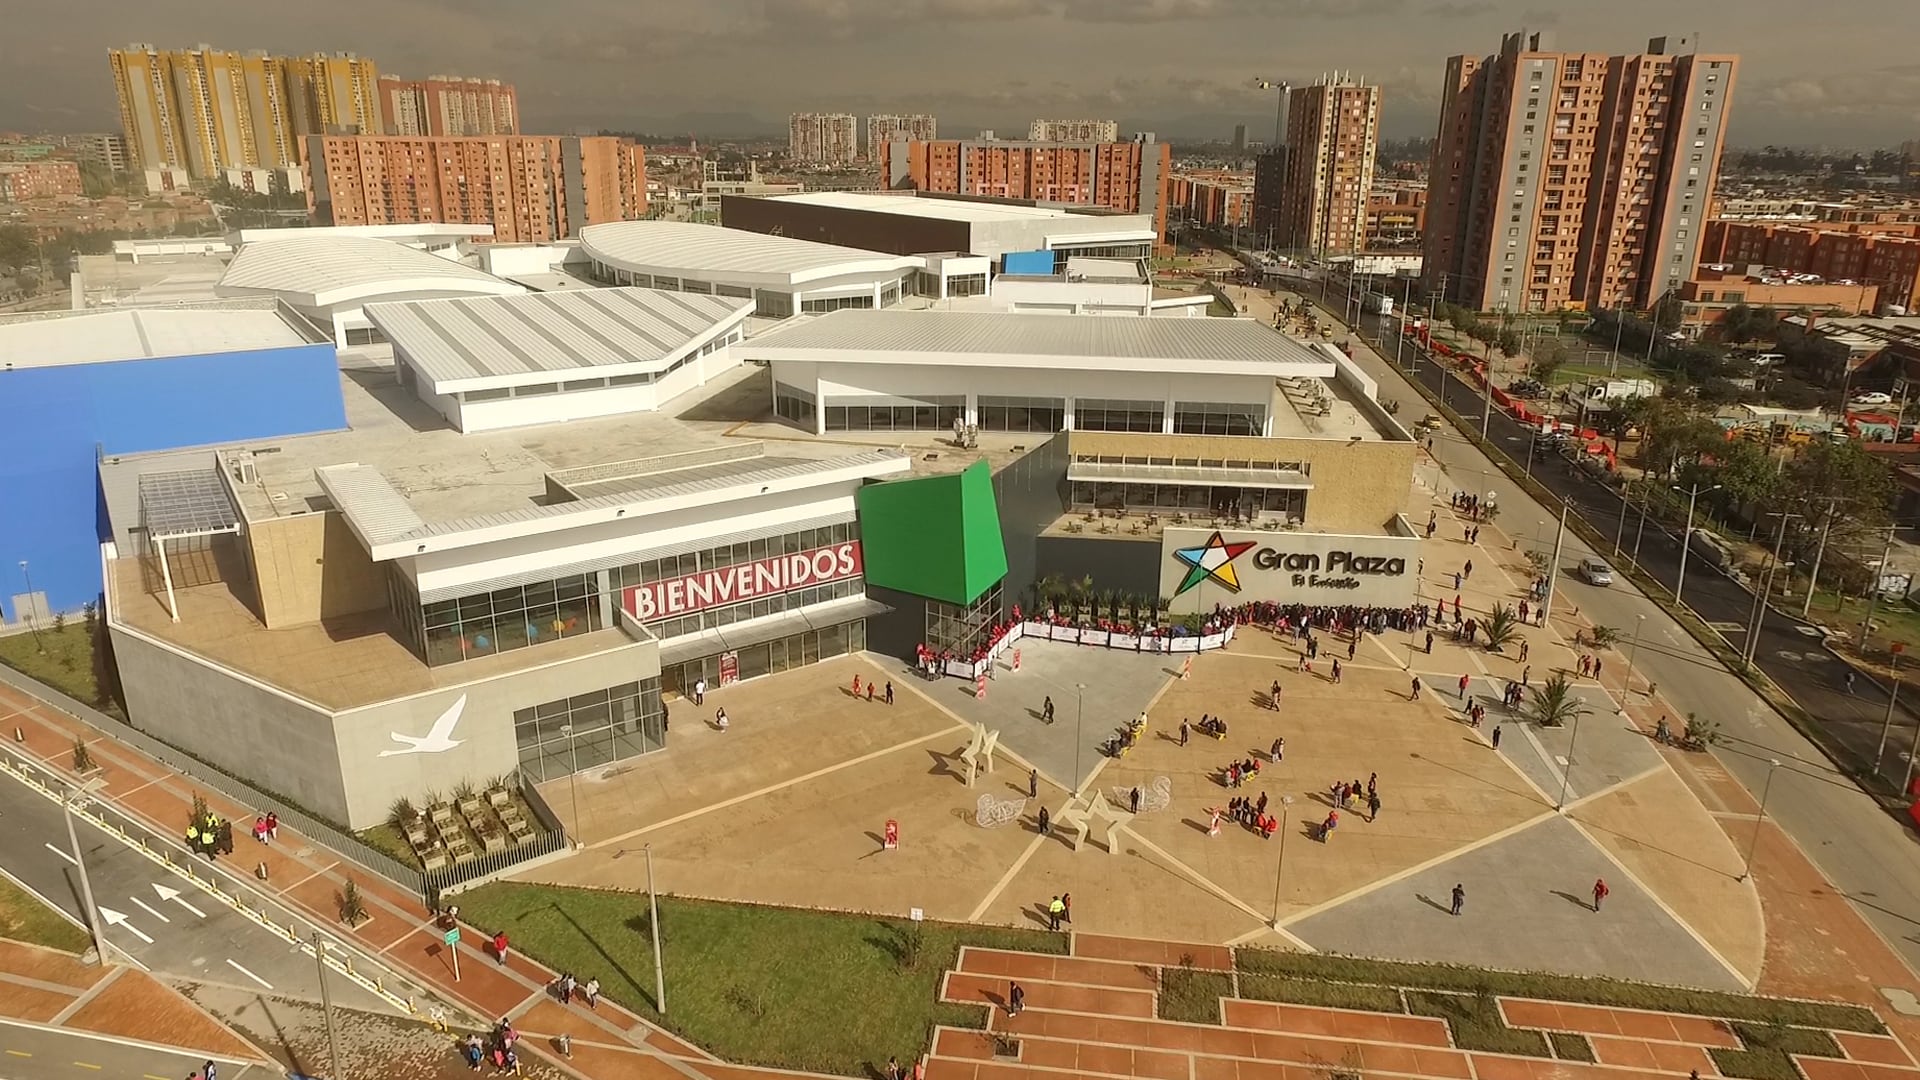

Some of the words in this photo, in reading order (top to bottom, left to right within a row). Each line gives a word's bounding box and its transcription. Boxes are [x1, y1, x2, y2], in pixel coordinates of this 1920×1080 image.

[1252, 548, 1320, 572] Gran
[1326, 551, 1405, 576] Plaza
[635, 545, 855, 619] BIENVENIDOS
[1291, 574, 1305, 587] El
